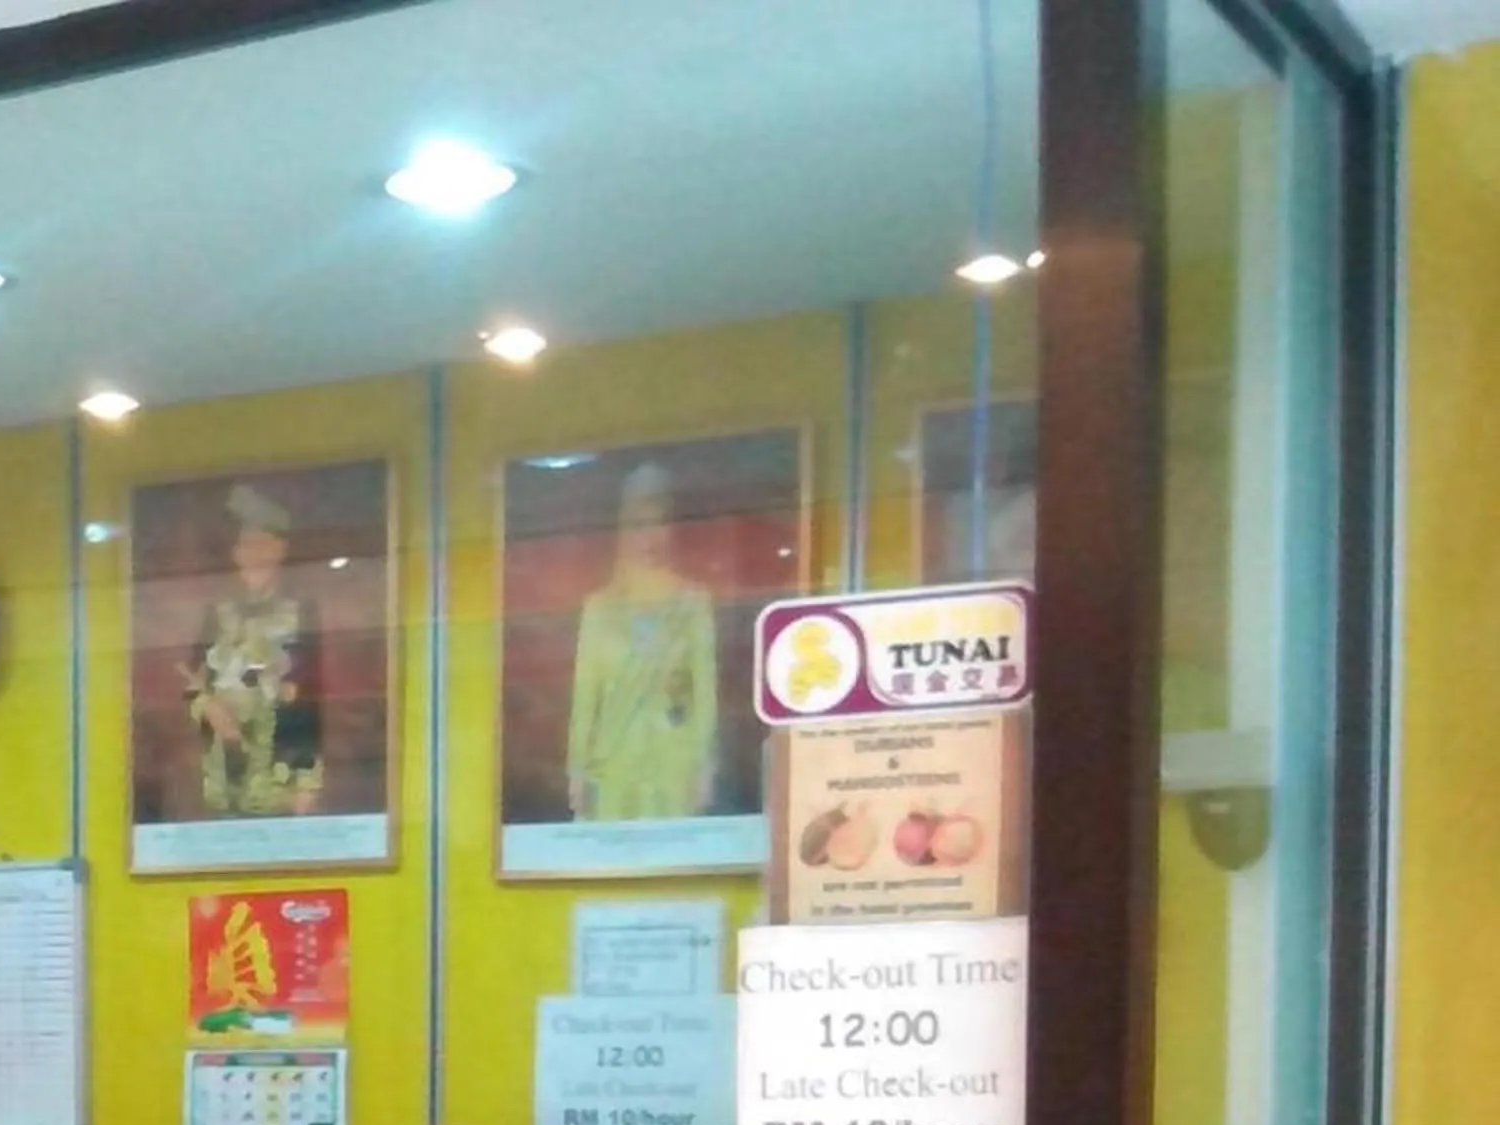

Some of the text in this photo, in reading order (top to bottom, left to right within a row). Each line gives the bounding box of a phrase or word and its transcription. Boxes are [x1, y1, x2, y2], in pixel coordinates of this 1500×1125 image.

[888, 635, 1012, 669] TUNAI
[739, 958, 917, 994] Check-out
[927, 952, 1021, 986] Time
[819, 1009, 940, 1049] 12:00
[760, 1066, 1000, 1101] Late Check-out
